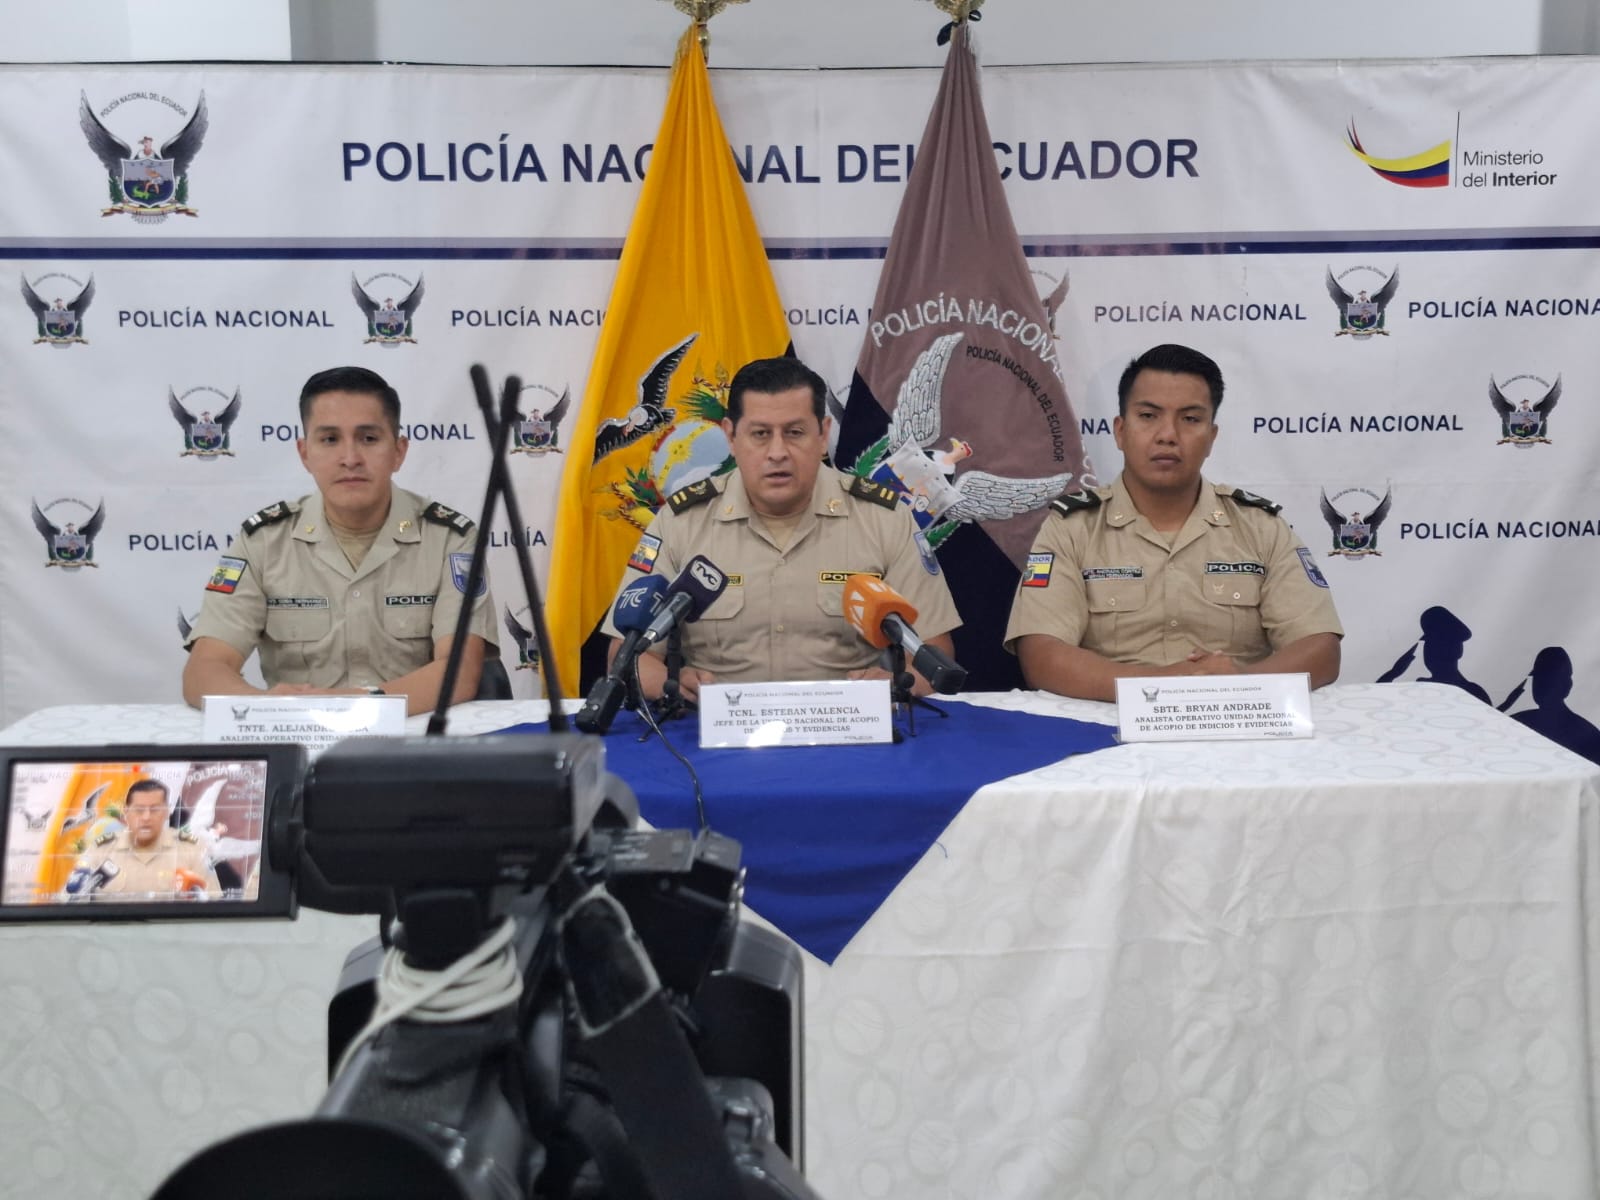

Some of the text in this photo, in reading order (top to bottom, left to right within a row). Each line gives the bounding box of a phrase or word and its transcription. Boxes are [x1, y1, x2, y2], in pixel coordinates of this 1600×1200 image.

[342, 133, 549, 183] POLICÍA
[991, 138, 1200, 181] CUADOR
[1463, 149, 1544, 166] Ministerio
[1462, 171, 1558, 187] del Interior
[451, 306, 607, 327] POLICÍA NACI
[785, 304, 860, 325] OLICÍA
[1094, 301, 1307, 323] POLICÍA NACIONAL
[1408, 296, 1600, 319] POLICÍA NACIONA
[118, 306, 335, 328] POLICÍA NACIONAL
[870, 292, 964, 348] POLICÍA
[1001, 357, 1041, 397] NACIONAL
[1037, 392, 1054, 414] DEL
[1047, 413, 1065, 463] ECUADOR
[406, 423, 475, 441] IONAL
[1253, 412, 1464, 434] POLICÍA NACIONAL
[1400, 518, 1490, 539] POLICÍA
[129, 530, 219, 551] POLICÍA
[389, 596, 433, 605] POLIC
[728, 706, 860, 718] TCNL. ESTEBAN VALENCIA
[1153, 702, 1272, 714] SBTE. BRYAN ANDRADE
[794, 717, 835, 725] NACIONAL
[1135, 716, 1174, 724] ANALISTA
[1175, 714, 1222, 722] OPERATIVO
[1224, 713, 1254, 721] UNIDAD
[1199, 722, 1235, 730] INDICIOS
[1244, 721, 1293, 729] EVIDENCIAS
[238, 724, 268, 733] TNTE.
[803, 725, 850, 733] EVIDENCIAS
[220, 734, 261, 742] ANALISTA
[263, 734, 312, 742] OPERATIVO
